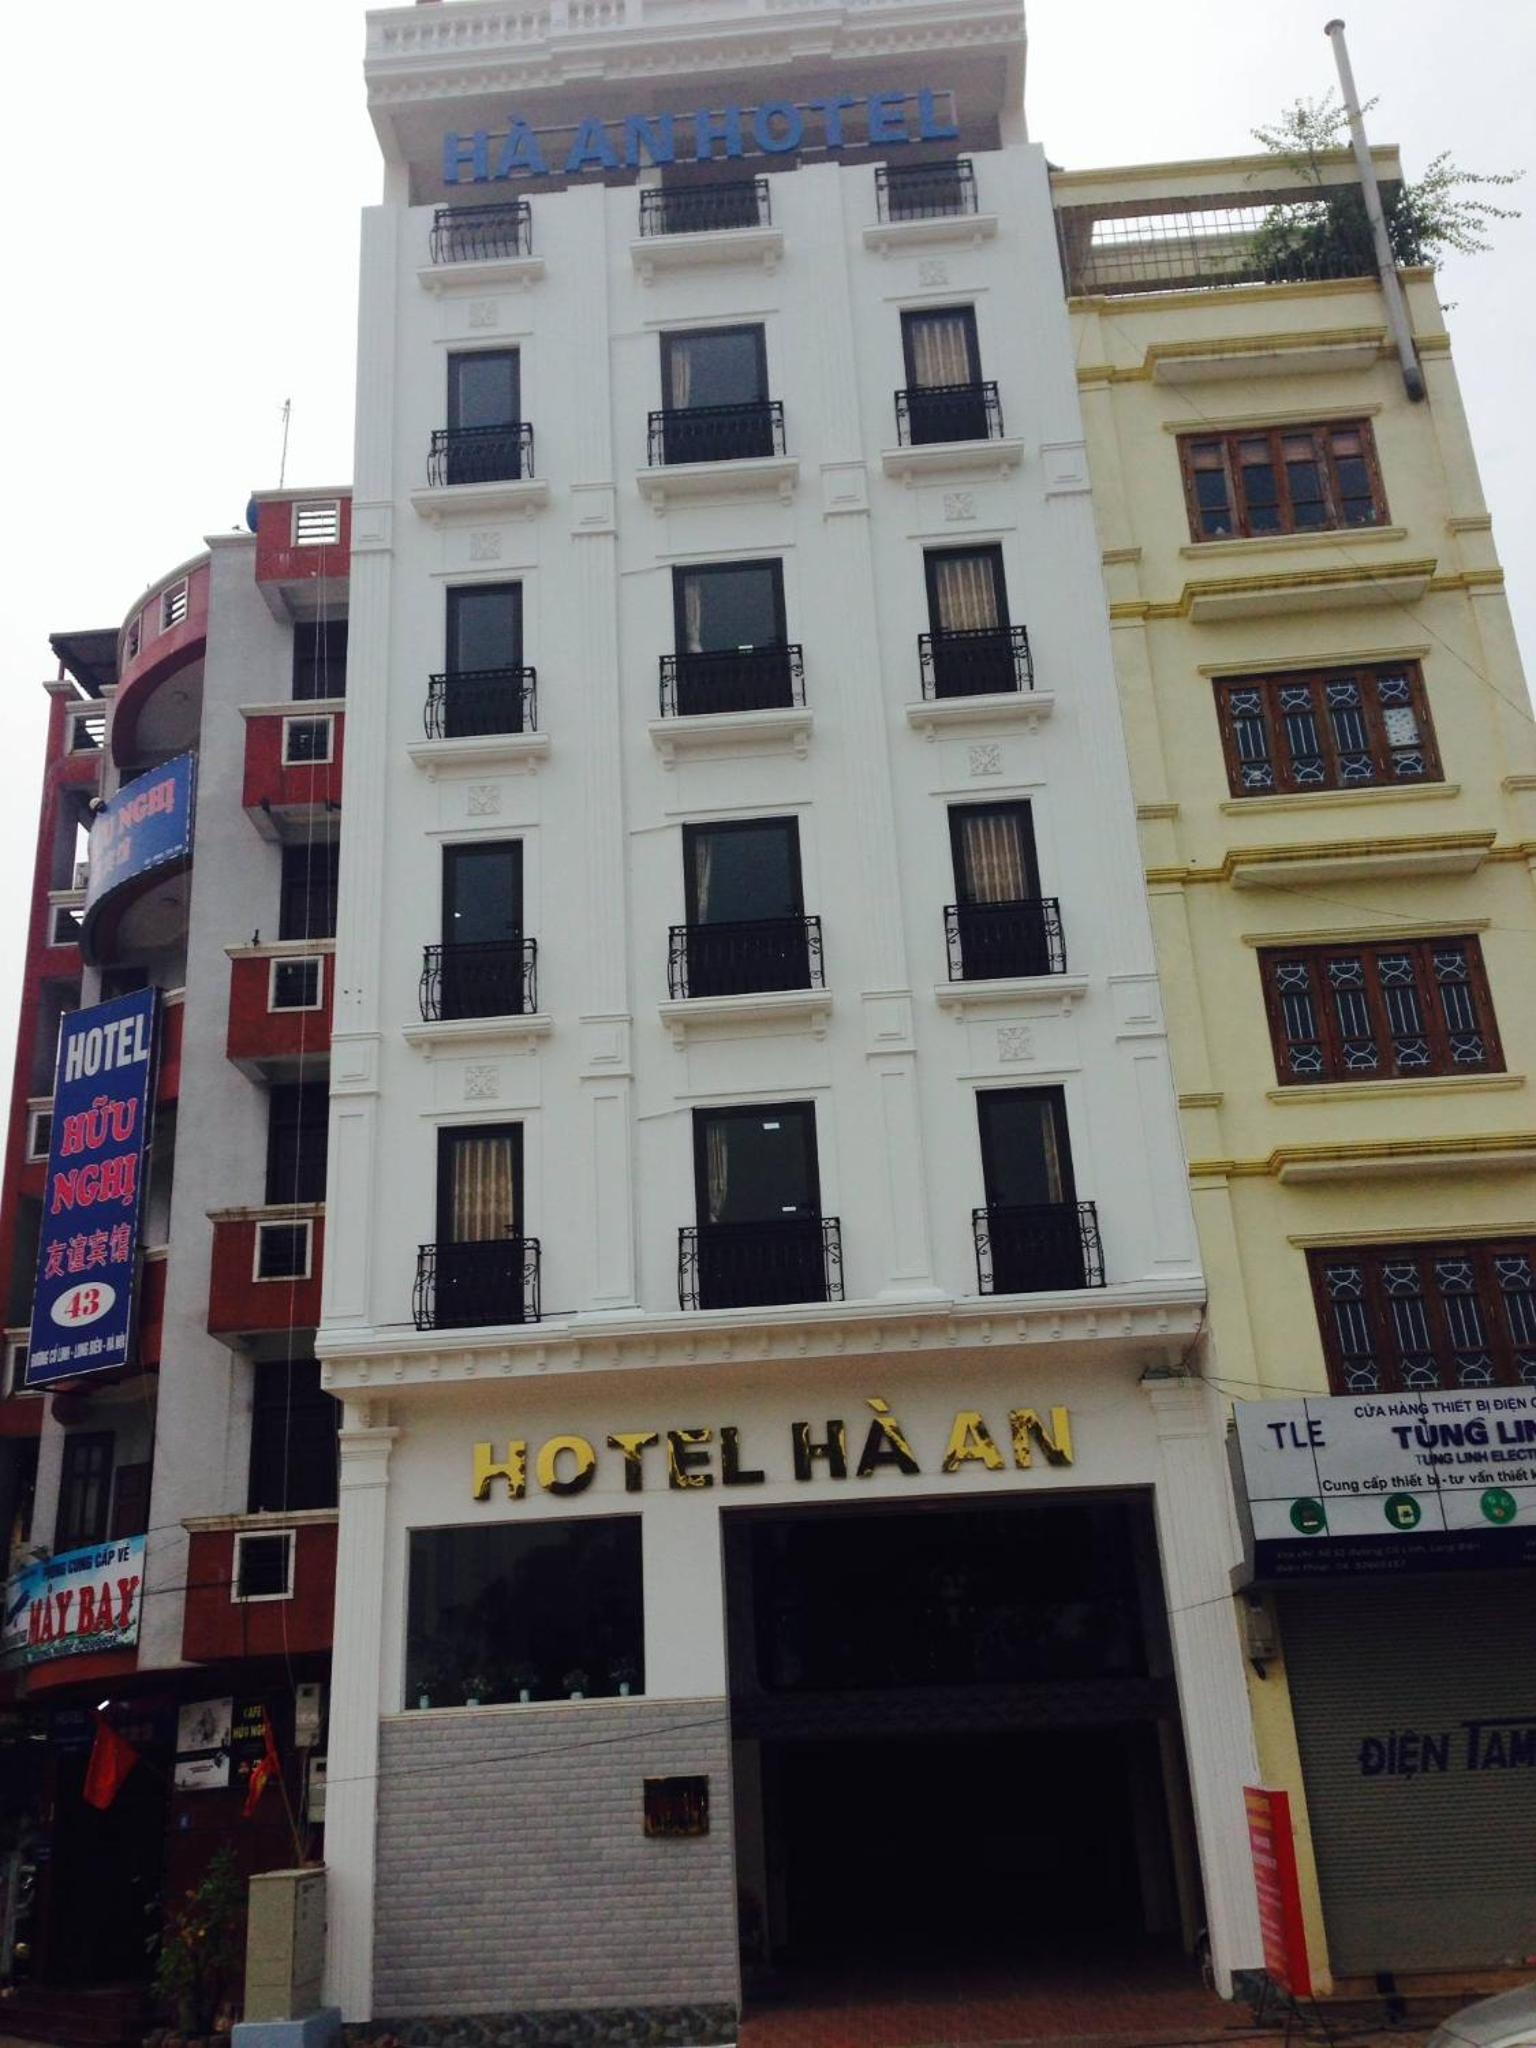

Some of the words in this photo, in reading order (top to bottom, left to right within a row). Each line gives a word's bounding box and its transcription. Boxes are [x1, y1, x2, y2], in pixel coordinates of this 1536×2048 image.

[444, 114, 549, 184] HÀ
[565, 114, 675, 173] AN
[696, 88, 959, 162] HOTEL
[65, 1012, 148, 1082] HOTEL
[60, 1096, 138, 1157] HỮU
[51, 1152, 138, 1215] NGHỊ
[65, 1288, 100, 1320] 43
[1389, 1401, 1430, 1417] HÀNG
[1476, 1399, 1491, 1414] BỊ
[1391, 1417, 1489, 1450] TÙNG
[473, 1426, 765, 1501] HOTEL
[792, 1397, 921, 1479] HÀ
[943, 1405, 1074, 1474] AN
[1268, 1419, 1326, 1450] TLE
[1456, 1451, 1489, 1464] LINH
[1322, 1479, 1360, 1493] Cung
[1363, 1475, 1388, 1491] cấp
[1391, 1473, 1424, 1488] thiết
[1469, 1469, 1495, 1484] vấn
[1497, 1468, 1528, 1483] thiết
[77, 1575, 140, 1636] BAY
[1358, 1728, 1451, 1779] ĐIỆN
